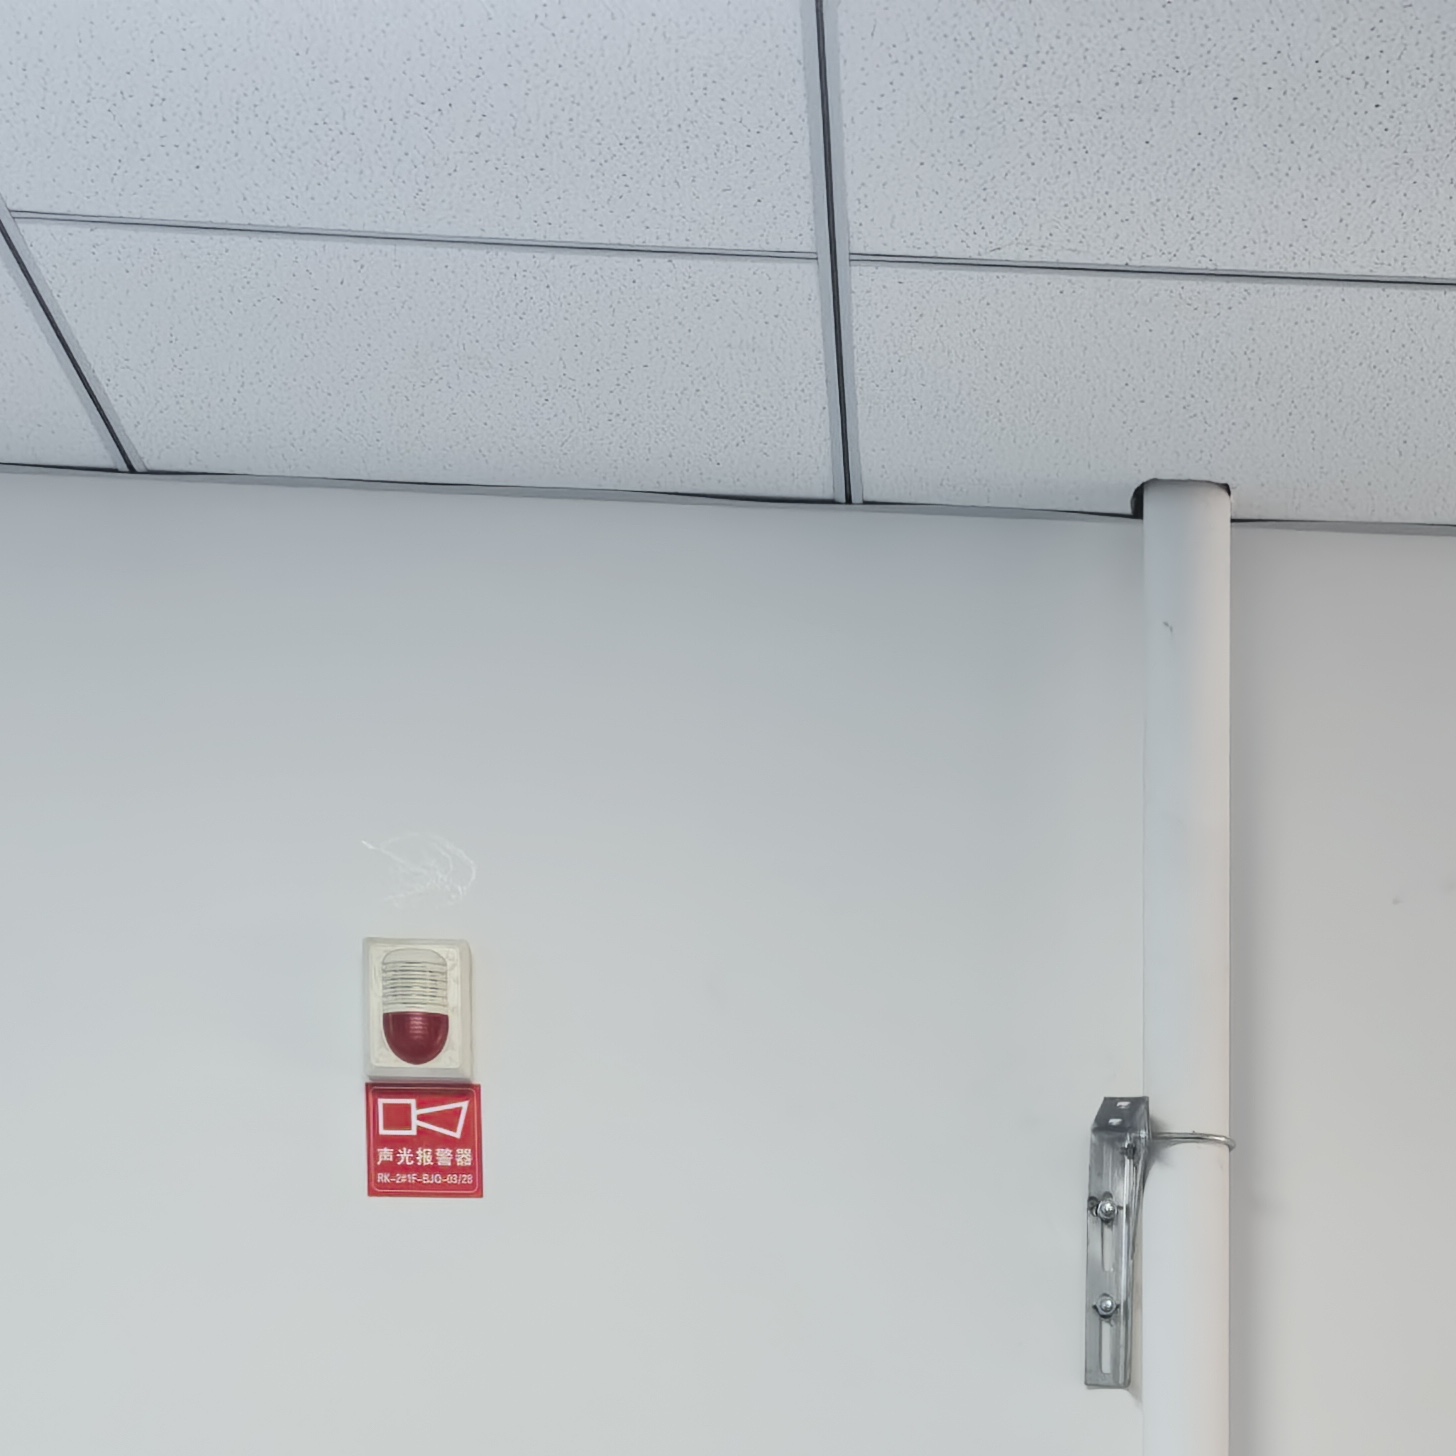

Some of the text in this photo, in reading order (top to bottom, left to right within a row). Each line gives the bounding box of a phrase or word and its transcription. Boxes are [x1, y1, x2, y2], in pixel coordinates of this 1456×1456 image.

[377, 1147, 473, 1166] 声光报警器
